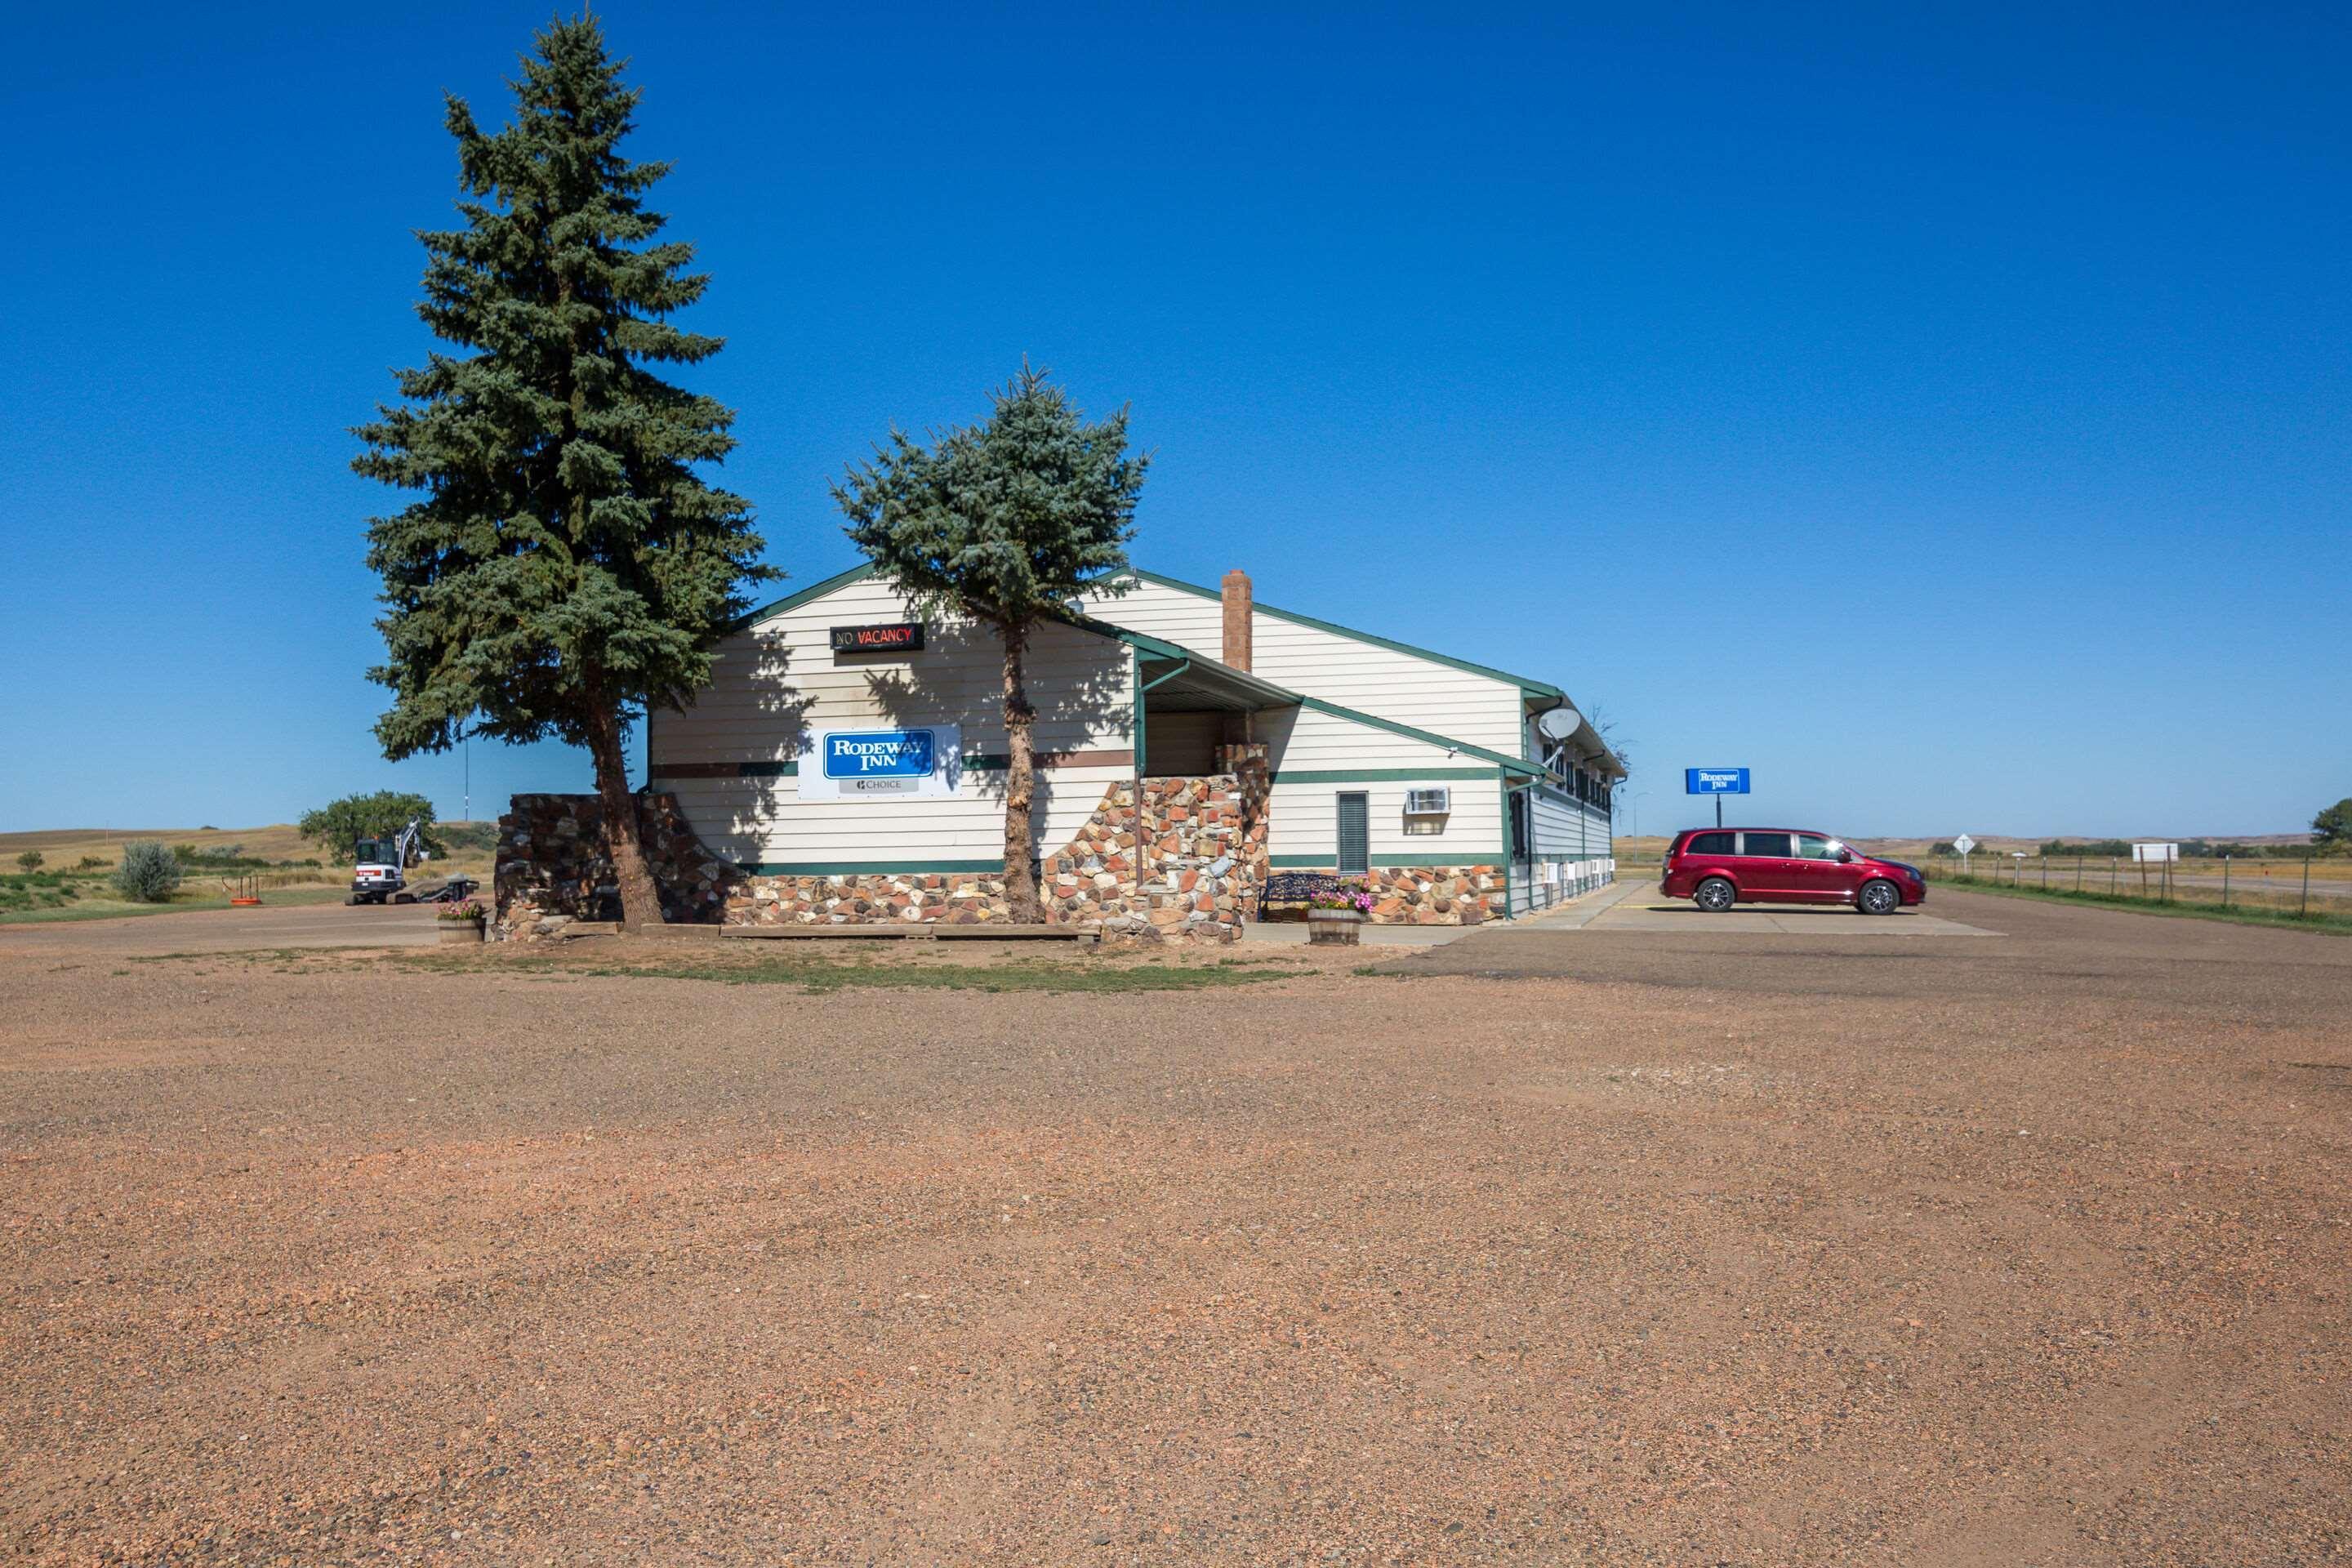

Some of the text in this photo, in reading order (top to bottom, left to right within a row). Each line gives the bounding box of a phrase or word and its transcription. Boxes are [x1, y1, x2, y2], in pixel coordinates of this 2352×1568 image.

[835, 627, 911, 645] NO VACANCY
[833, 739, 922, 756] RODEWAY
[860, 755, 897, 771] INN
[866, 780, 902, 790] CHOICE
